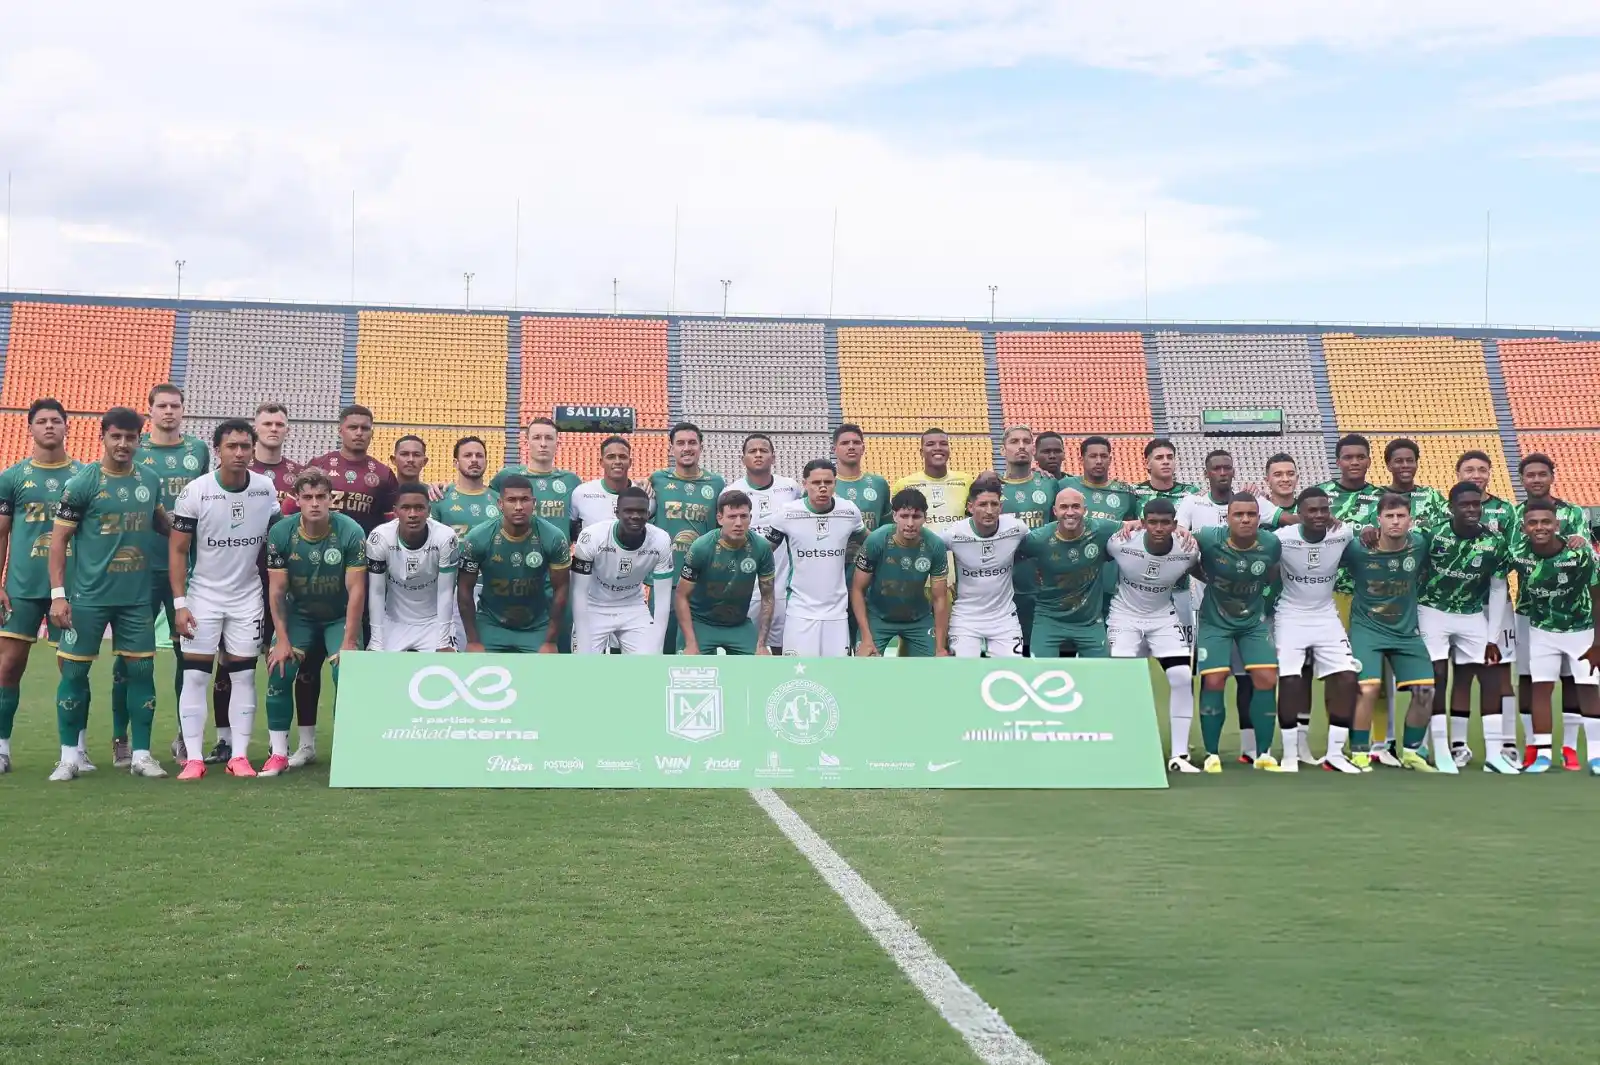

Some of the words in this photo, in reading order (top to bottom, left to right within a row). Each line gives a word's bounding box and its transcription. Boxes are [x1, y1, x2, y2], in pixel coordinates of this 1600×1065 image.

[566, 407, 621, 417] SALIDA
[623, 408, 631, 418] 2
[347, 491, 374, 503] zero
[345, 499, 371, 513] um
[925, 514, 965, 525] etsson
[207, 536, 263, 548] betsson
[797, 548, 845, 559] betsson
[1286, 572, 1338, 585] betsson
[1503, 629, 1516, 648] 14
[427, 717, 475, 726] partido
[486, 755, 534, 772] Pilsen
[654, 755, 691, 769] WIN
